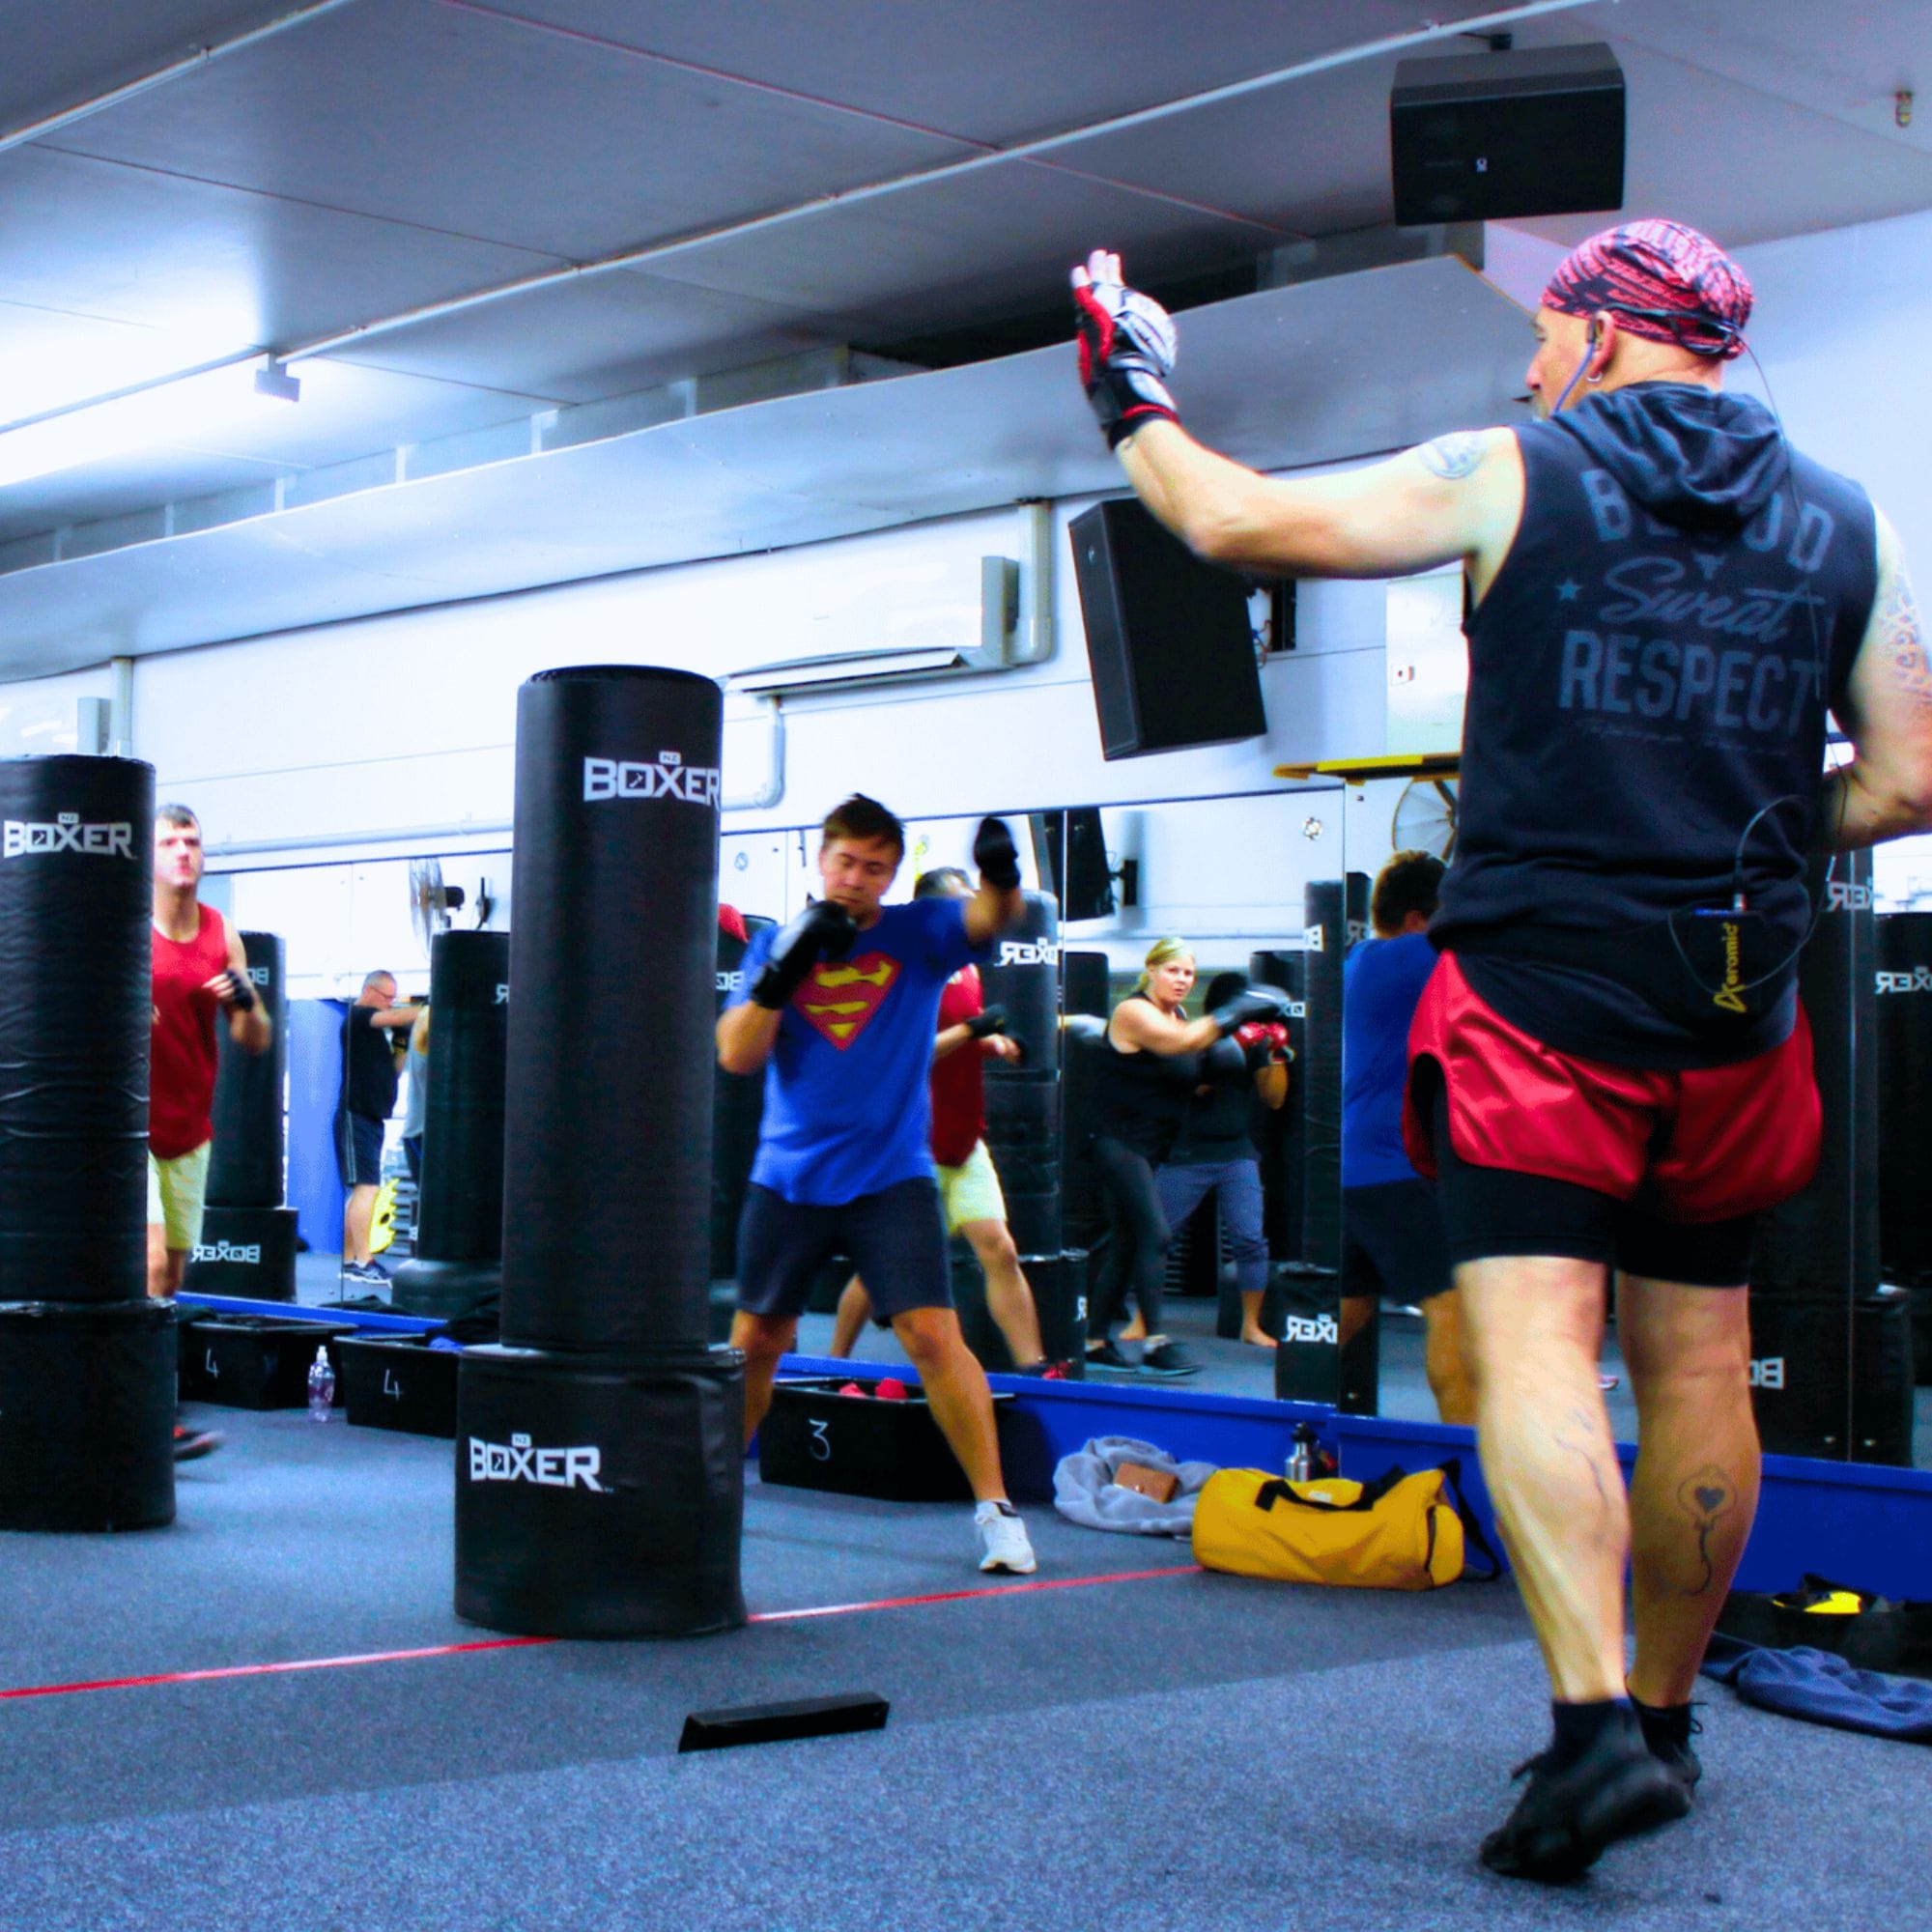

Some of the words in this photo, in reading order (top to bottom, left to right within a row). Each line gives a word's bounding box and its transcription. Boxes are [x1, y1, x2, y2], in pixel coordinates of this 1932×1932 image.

[1598, 554, 1826, 643] Sweat
[1558, 629, 1828, 737] RESPECT
[583, 756, 721, 812] BOXER
[4, 820, 134, 859] BOXER
[206, 1349, 219, 1379] 4
[384, 1369, 403, 1401] 4
[469, 1436, 604, 1492] BOXER
[809, 1418, 831, 1461] 3
